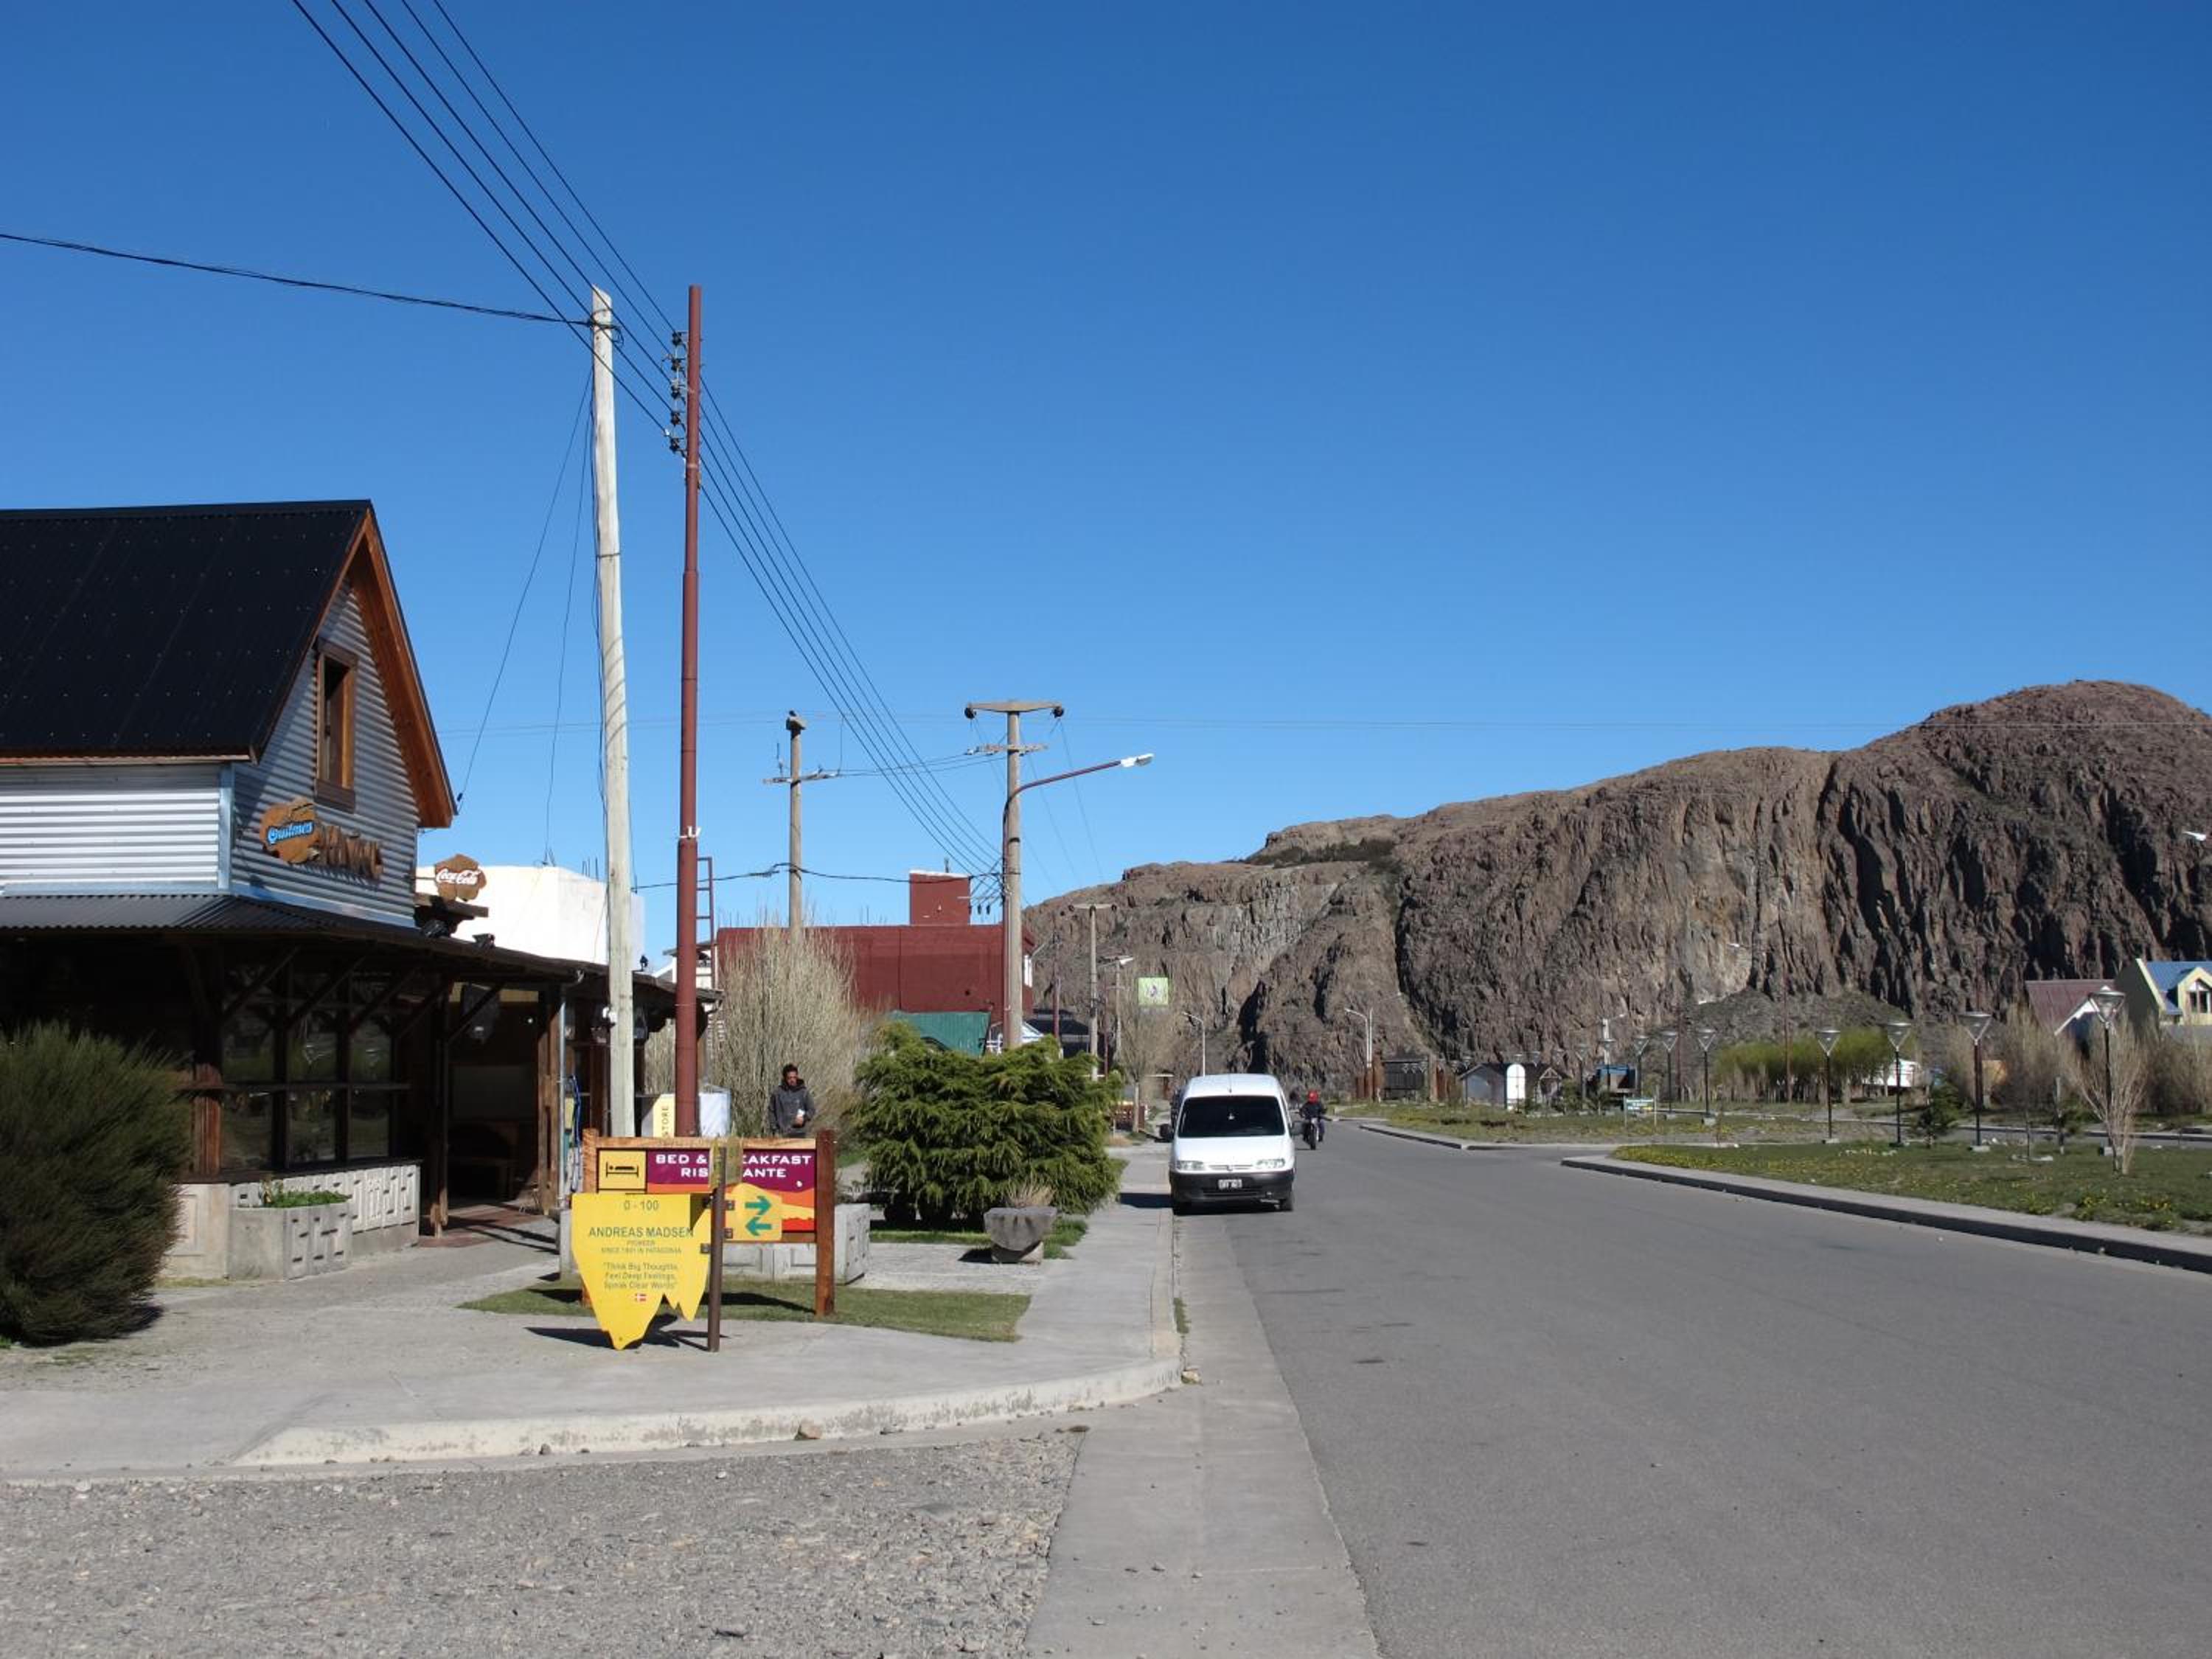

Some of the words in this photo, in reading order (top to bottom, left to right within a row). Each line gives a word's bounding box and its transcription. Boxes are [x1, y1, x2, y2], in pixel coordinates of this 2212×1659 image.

[655, 1154, 689, 1164] BED
[696, 1154, 707, 1164] &
[681, 1167, 787, 1178] RISANTE
[641, 1200, 659, 1211] 100
[589, 1227, 644, 1237] ANDREAS
[646, 1227, 694, 1237] MADSEN
[622, 1273, 642, 1281] Deep
